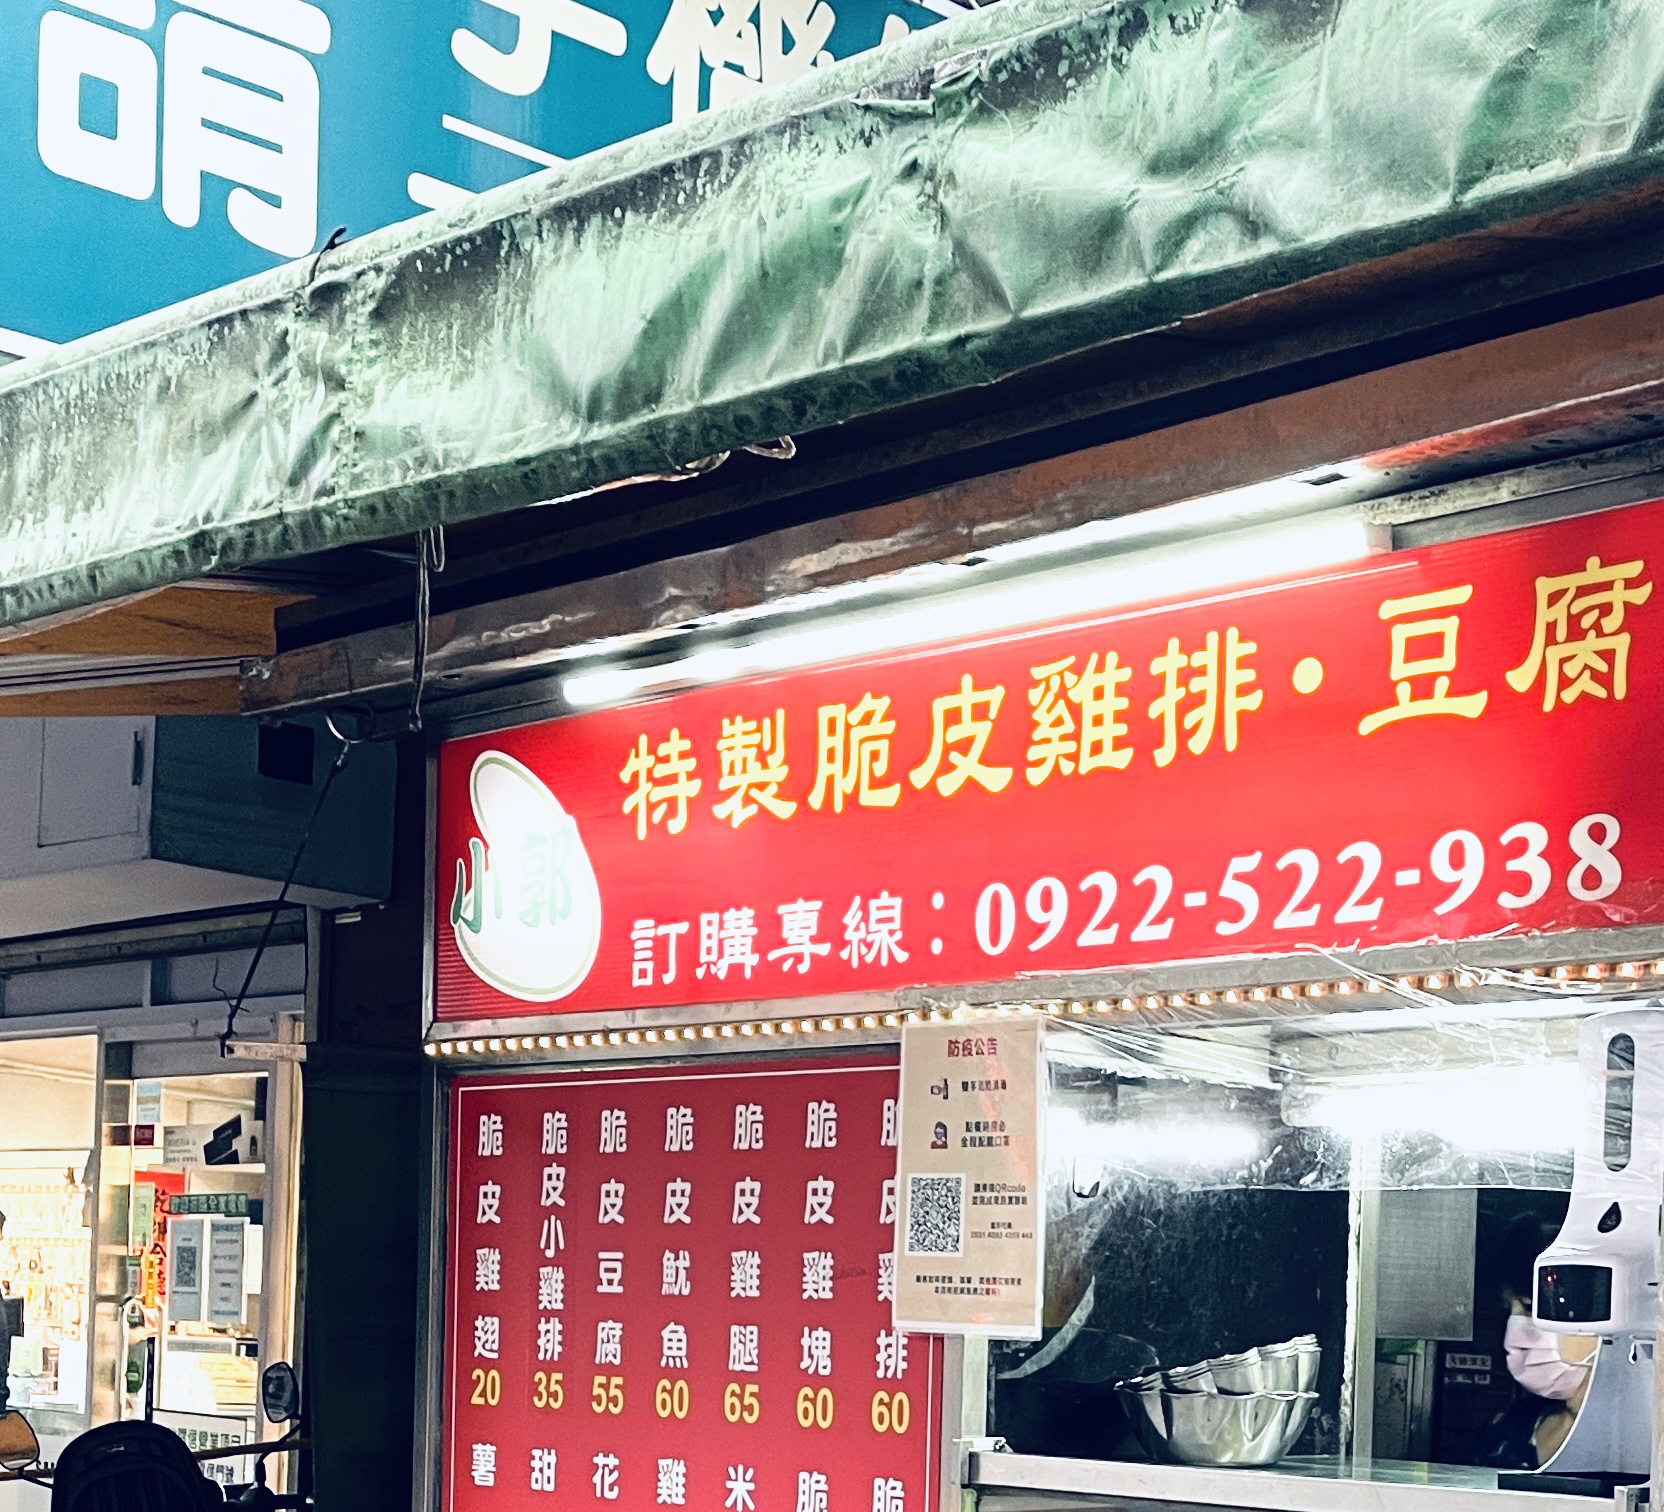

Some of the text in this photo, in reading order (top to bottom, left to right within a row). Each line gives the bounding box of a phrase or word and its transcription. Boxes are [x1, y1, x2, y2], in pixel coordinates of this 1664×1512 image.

[451, 826, 573, 934] 小郭
[471, 1113, 504, 1407] 脆皮雞翅 20
[533, 1110, 568, 1409] 脆皮小雞排 35
[591, 1108, 628, 1415] 脆皮豆腐 55
[655, 1105, 694, 1420] 脆皮魷魚 60
[723, 1102, 764, 1425] 脆皮雞腿 65
[796, 1099, 838, 1430] 脆皮雞塊 60
[870, 1390, 911, 1435] 60
